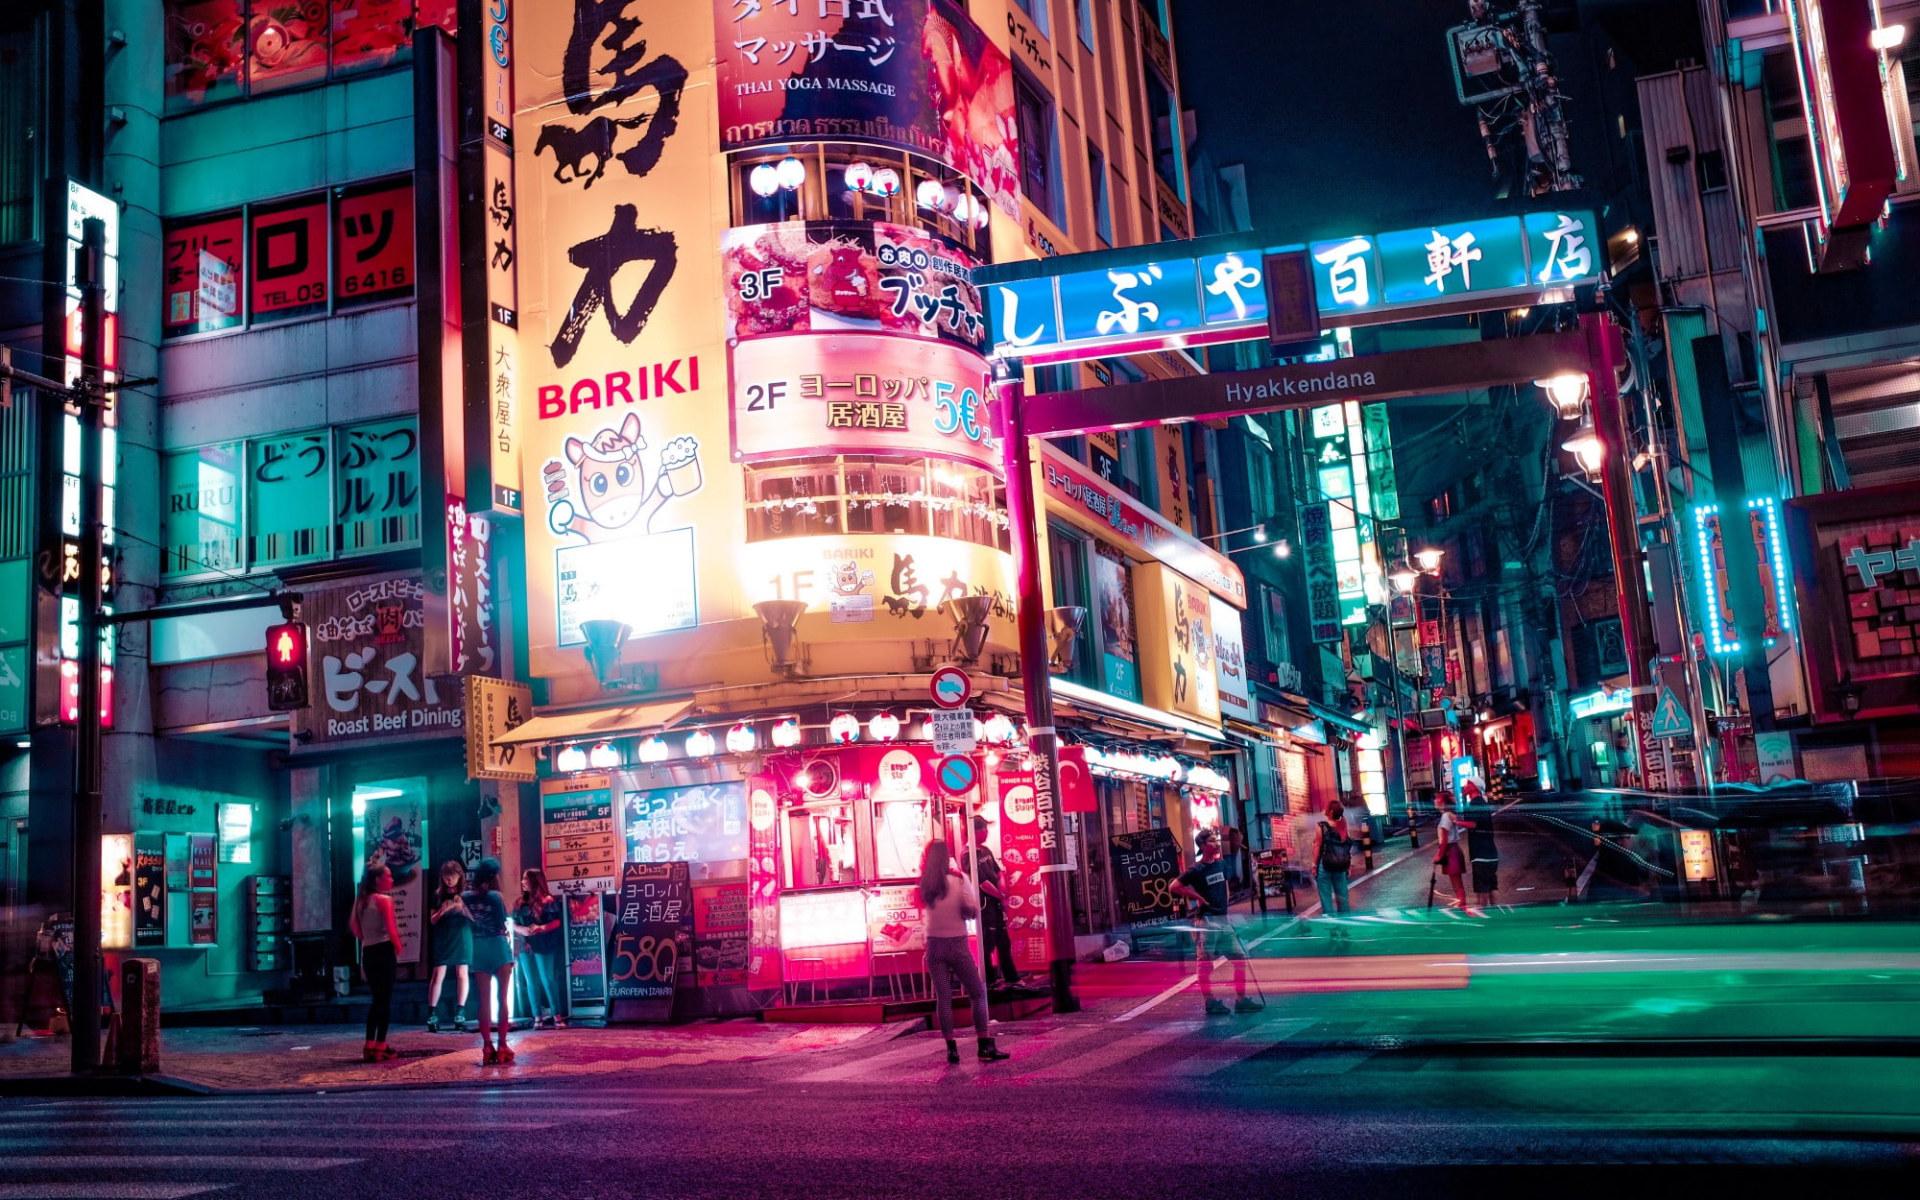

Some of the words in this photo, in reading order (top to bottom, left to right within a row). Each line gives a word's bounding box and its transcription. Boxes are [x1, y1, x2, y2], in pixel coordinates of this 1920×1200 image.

[734, 29, 896, 67] マッサージ
[735, 79, 772, 97] THAI
[778, 76, 822, 91] YOGA
[827, 77, 897, 97] MASSAGE
[493, 122, 508, 140] 2F
[880, 245, 926, 269] お肉の
[345, 266, 406, 293] 6416
[740, 269, 782, 299] 3F
[497, 307, 512, 322] 1F
[880, 274, 984, 337] ブッチャ
[495, 343, 511, 454] 大衆屋台
[537, 354, 700, 421] BARIKI
[1226, 370, 1378, 404] Hyakkendana
[747, 382, 787, 412] 2F
[800, 374, 929, 401] ヨーロッパ
[934, 381, 980, 441] 5€
[826, 401, 908, 431] 居酒屋
[256, 427, 417, 483] どうぶつ
[1100, 455, 1113, 482] 3F
[171, 485, 234, 513] RURU
[339, 470, 418, 519] ルル
[501, 489, 517, 506] 1F
[469, 515, 495, 672] ローストビーフ
[328, 717, 369, 737] Roast
[373, 712, 408, 731] Beef
[411, 706, 462, 727] Dining
[597, 807, 610, 816] 5F
[1127, 861, 1172, 880] FOOD
[626, 883, 684, 899] ヨーロッパ
[621, 900, 683, 925] 居酒屋
